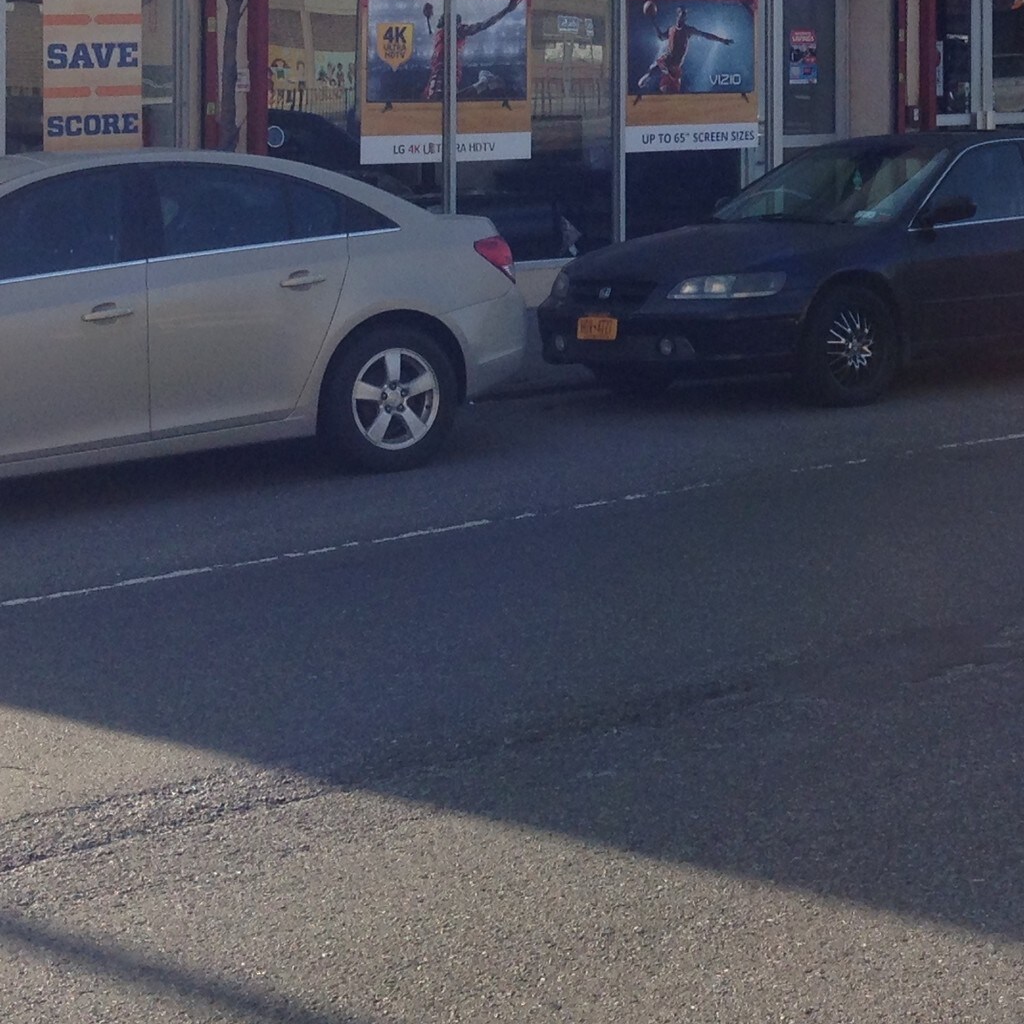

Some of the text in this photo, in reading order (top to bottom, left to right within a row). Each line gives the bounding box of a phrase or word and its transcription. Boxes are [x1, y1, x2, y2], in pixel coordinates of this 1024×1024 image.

[382, 26, 407, 44] 4K
[47, 42, 139, 70] SAVE
[709, 73, 742, 85] VIZIO
[47, 112, 139, 137] SCORE
[641, 134, 656, 145] UP
[657, 133, 672, 144] TO
[692, 131, 729, 144] SCREEN
[731, 130, 755, 142] SIZES
[393, 144, 405, 155] LG
[408, 144, 420, 154] 4K
[468, 142, 496, 153] HDTV
